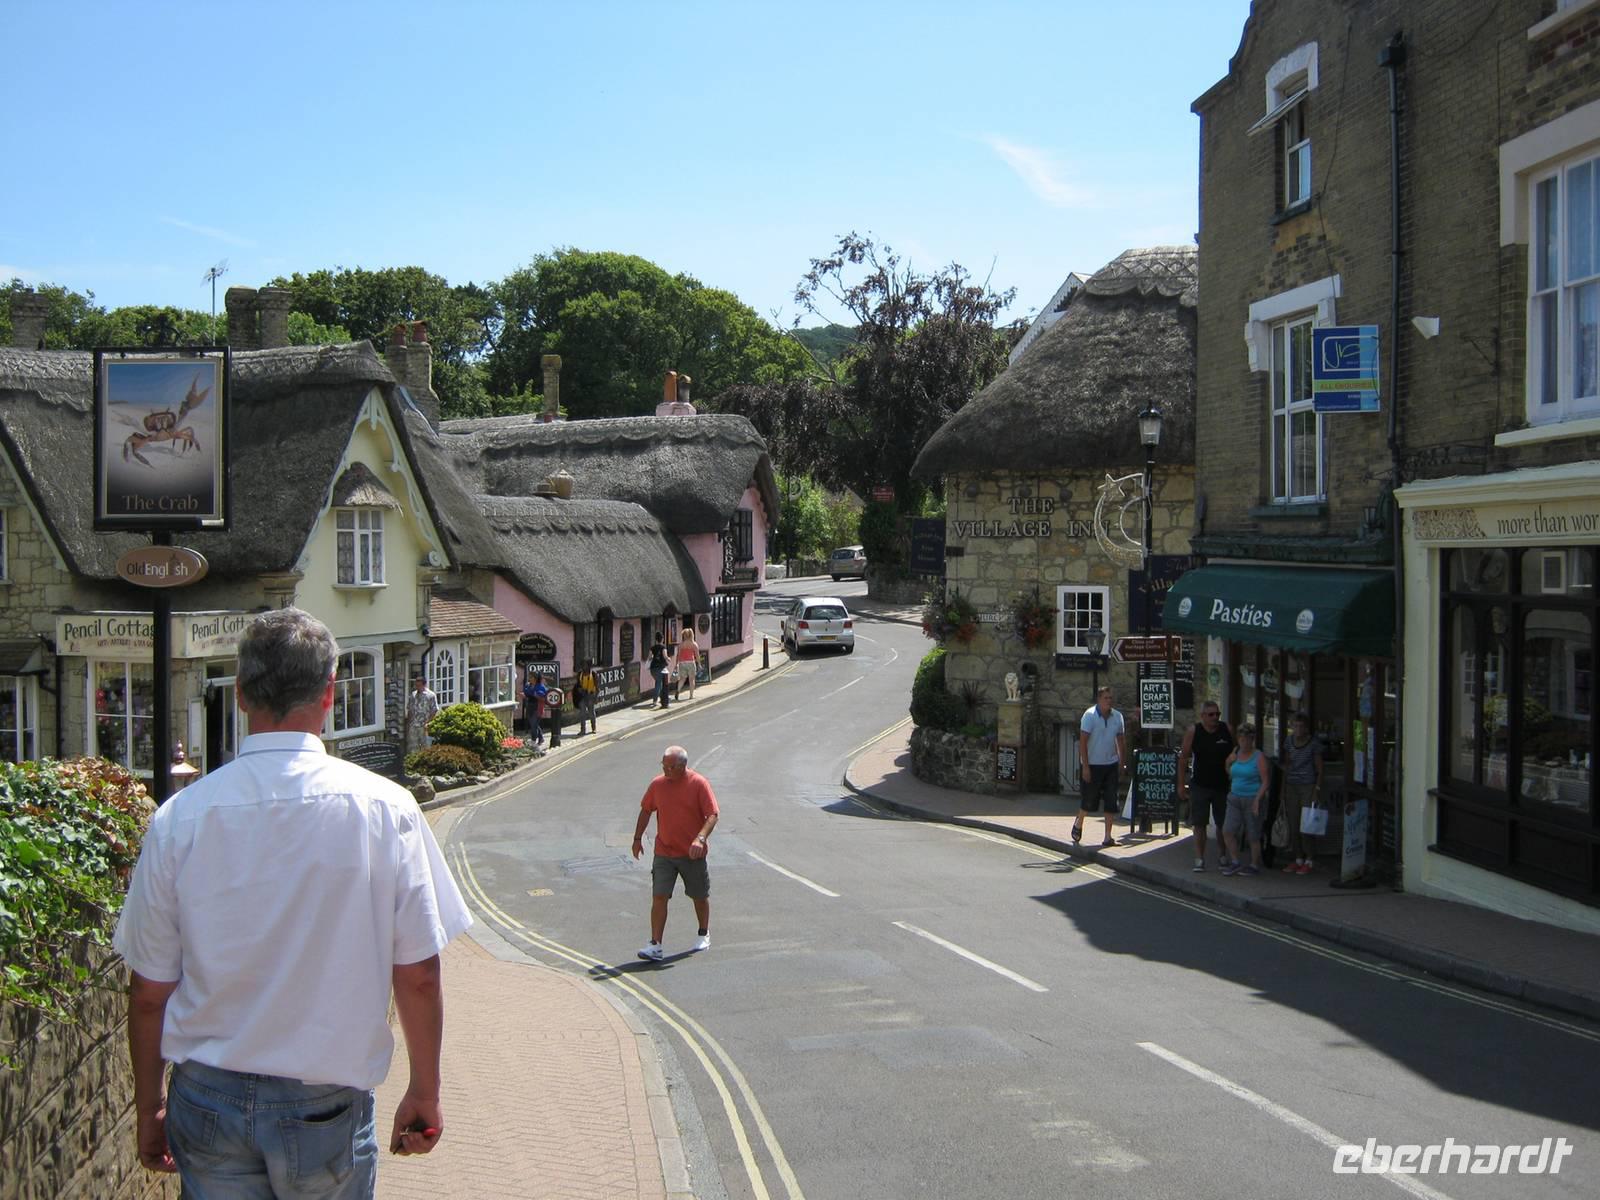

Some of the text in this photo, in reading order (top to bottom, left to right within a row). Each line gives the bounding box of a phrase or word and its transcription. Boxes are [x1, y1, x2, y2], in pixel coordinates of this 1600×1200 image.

[122, 495, 199, 510] The Crab
[1008, 497, 1055, 514] THE
[1497, 518, 1531, 535] more
[1534, 504, 1568, 533] than
[953, 521, 1051, 537] VILLAGE
[724, 535, 735, 576] GARDEN
[1209, 599, 1272, 628] Pasties
[64, 618, 154, 641] Pencil Cottag
[191, 621, 220, 642] Pencil
[529, 664, 556, 673] OPEN
[600, 667, 625, 685] NERS
[1143, 684, 1168, 692] ART &
[1143, 693, 1170, 702] CRAFT
[1143, 702, 1170, 711] SHOPS
[1136, 762, 1177, 775] PASTIES
[1138, 782, 1176, 792] SAUSAGE
[1145, 792, 1169, 800] ROLLS
